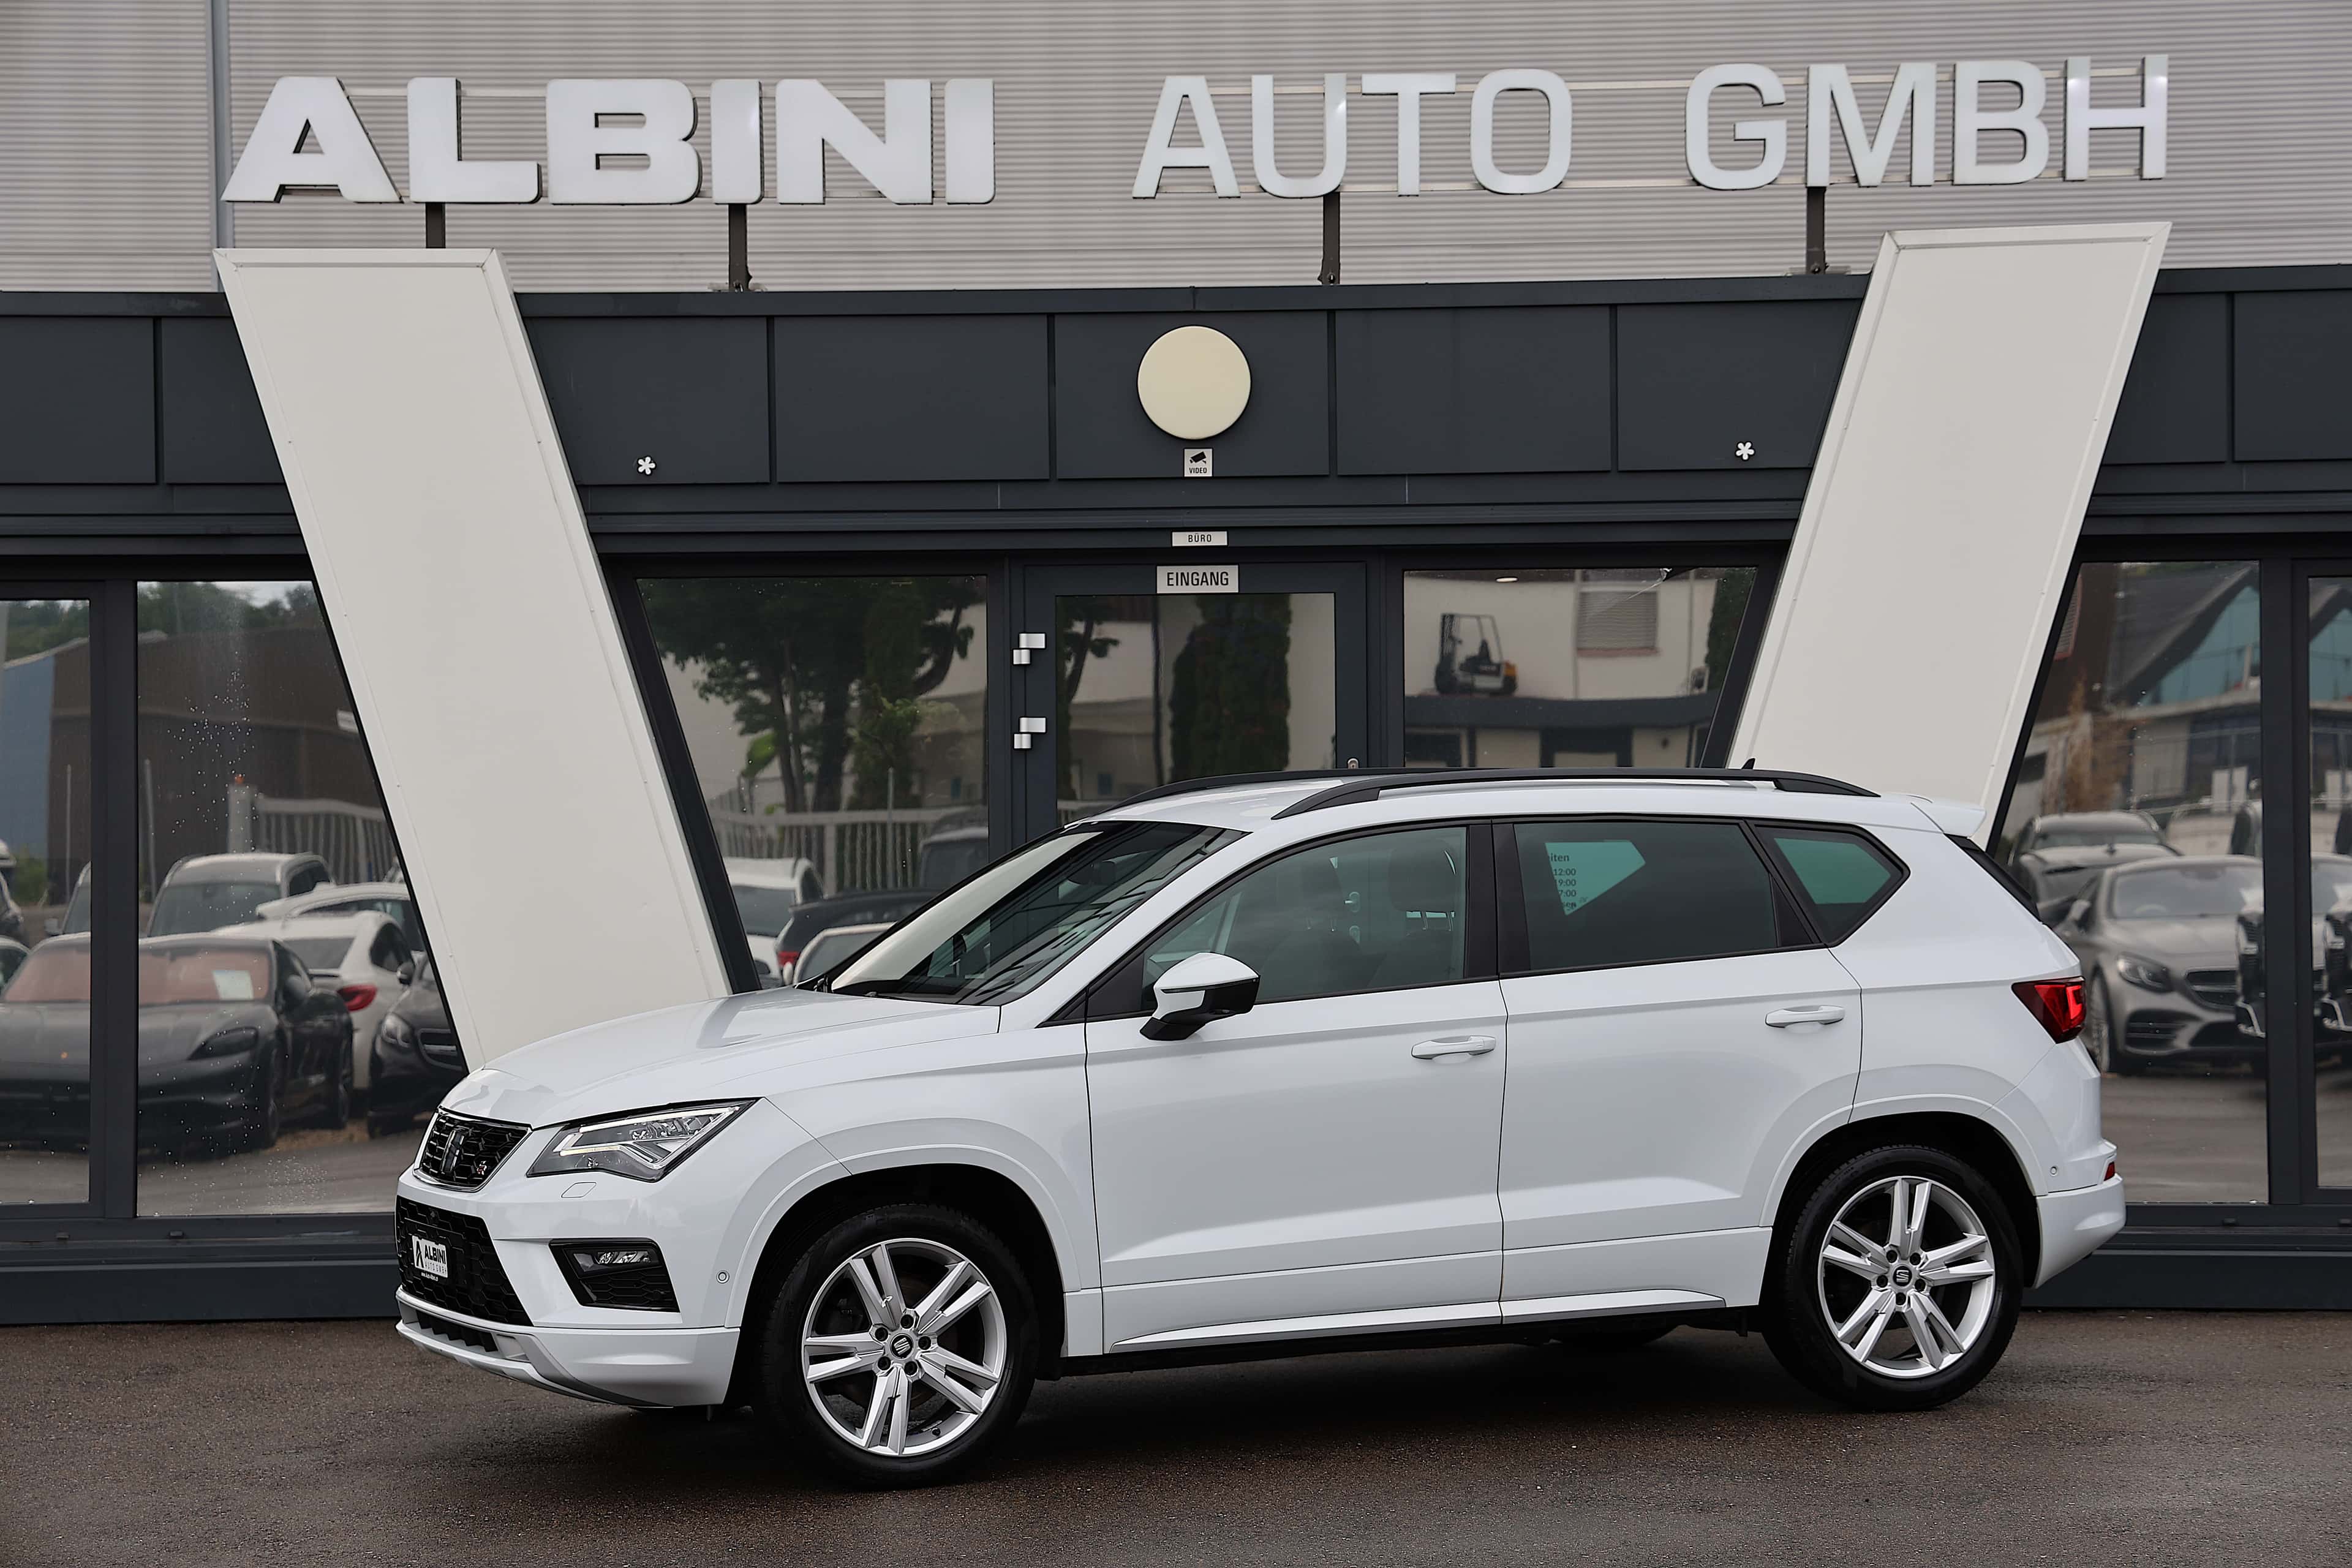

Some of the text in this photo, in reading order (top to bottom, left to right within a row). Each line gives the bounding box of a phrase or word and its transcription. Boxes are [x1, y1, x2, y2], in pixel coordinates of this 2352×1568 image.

[222, 54, 2169, 204] ALBINI AUTO GMBH
[1188, 533, 1212, 543] BÜRO
[1167, 571, 1229, 586] EINGANG
[1549, 853, 1569, 862] iten
[425, 1244, 446, 1265] ALBINI
